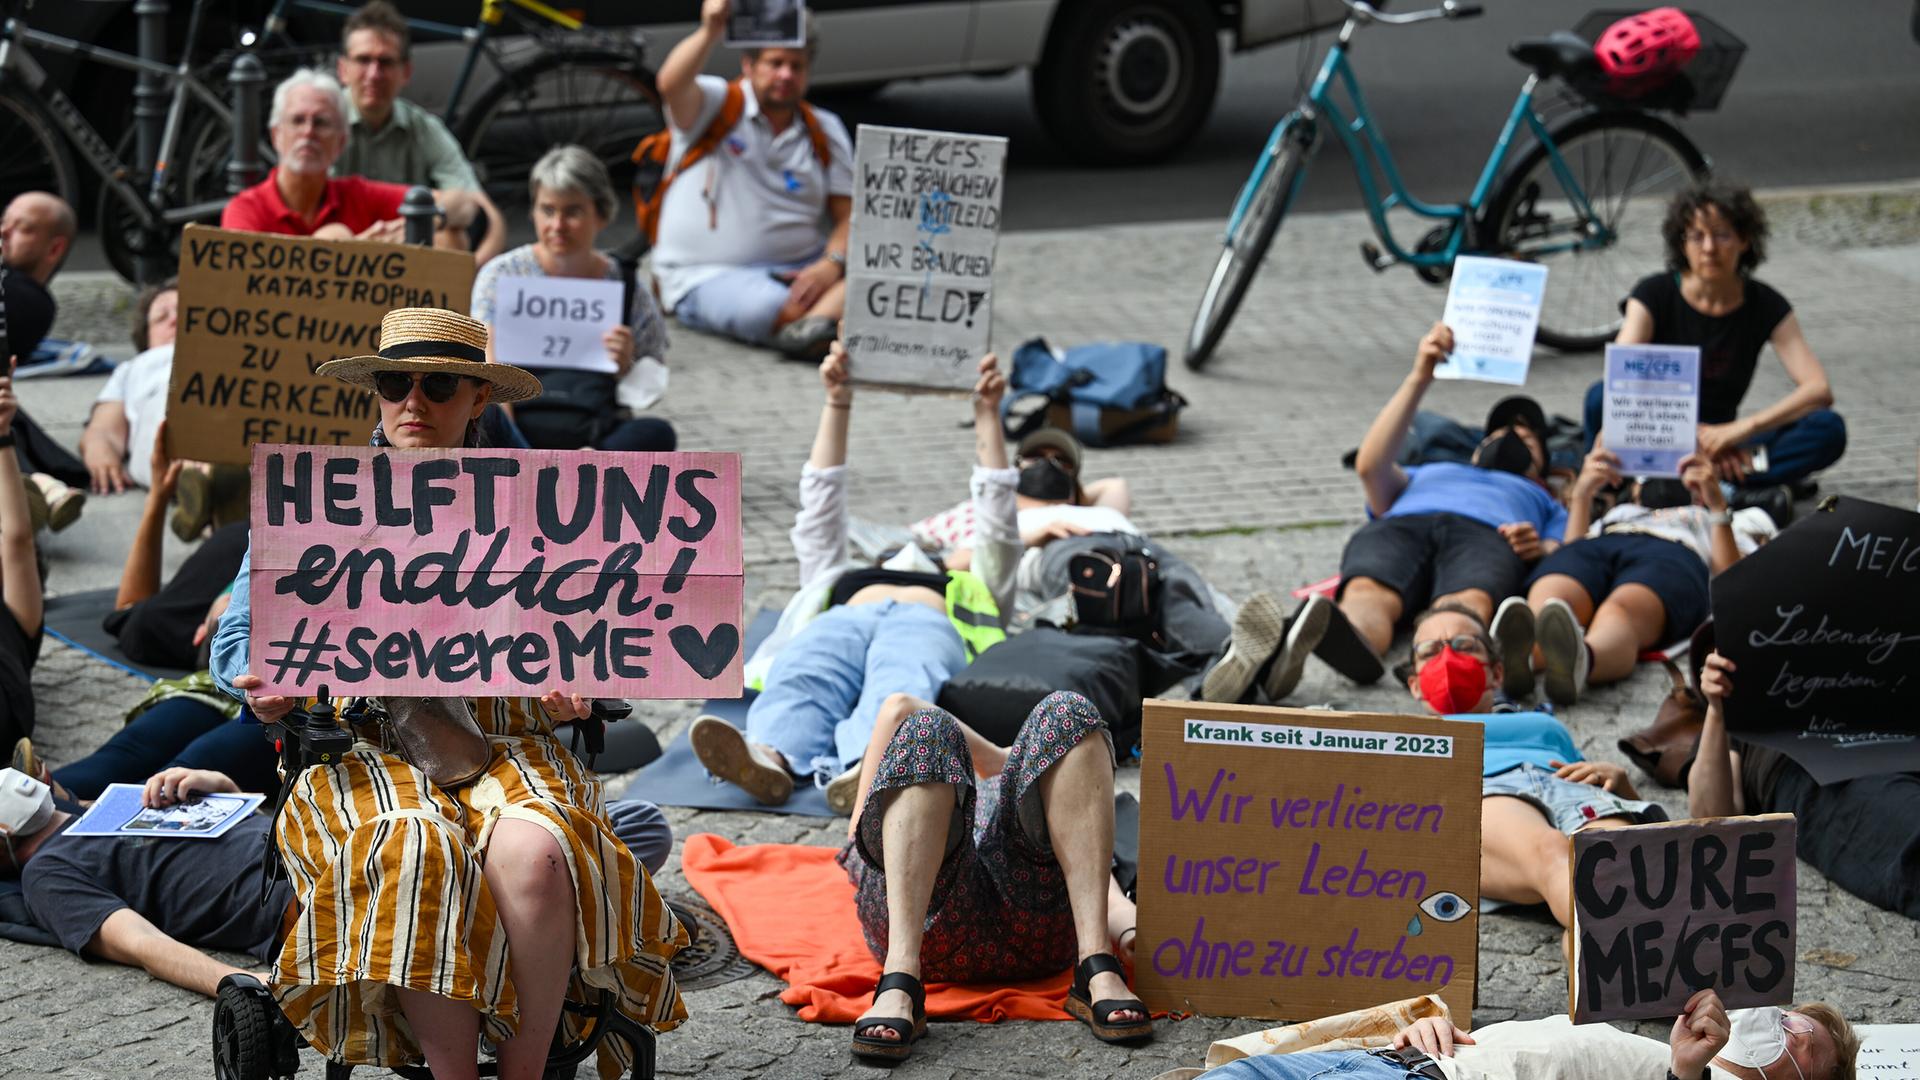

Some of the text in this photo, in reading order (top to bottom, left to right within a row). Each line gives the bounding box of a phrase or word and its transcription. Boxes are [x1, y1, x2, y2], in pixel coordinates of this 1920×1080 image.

[863, 162, 998, 201] WIR BRAUCHEN
[864, 192, 999, 230] KEIN MITLEID
[189, 239, 406, 279] VERSORGUNG
[864, 242, 992, 277] WIR BRAUCHEN
[511, 288, 605, 322] Jonas
[866, 281, 986, 328] GELD!
[241, 342, 280, 372] ZU
[542, 335, 572, 357] 27
[1624, 359, 1681, 376] ME/CFS
[266, 452, 718, 544] HELFT UNS
[274, 526, 698, 620] endlich!
[265, 617, 656, 686] #severeME
[1748, 604, 1920, 664] Lebendig
[1187, 723, 1449, 755] Krank seit Januar 2023
[1164, 762, 1444, 833] Wir verlieren
[1164, 842, 1427, 900] unser Leben
[1574, 831, 1776, 920] CURE
[1152, 916, 1454, 986] ohne zu sterben
[1581, 914, 1789, 1012] ME/CFS
